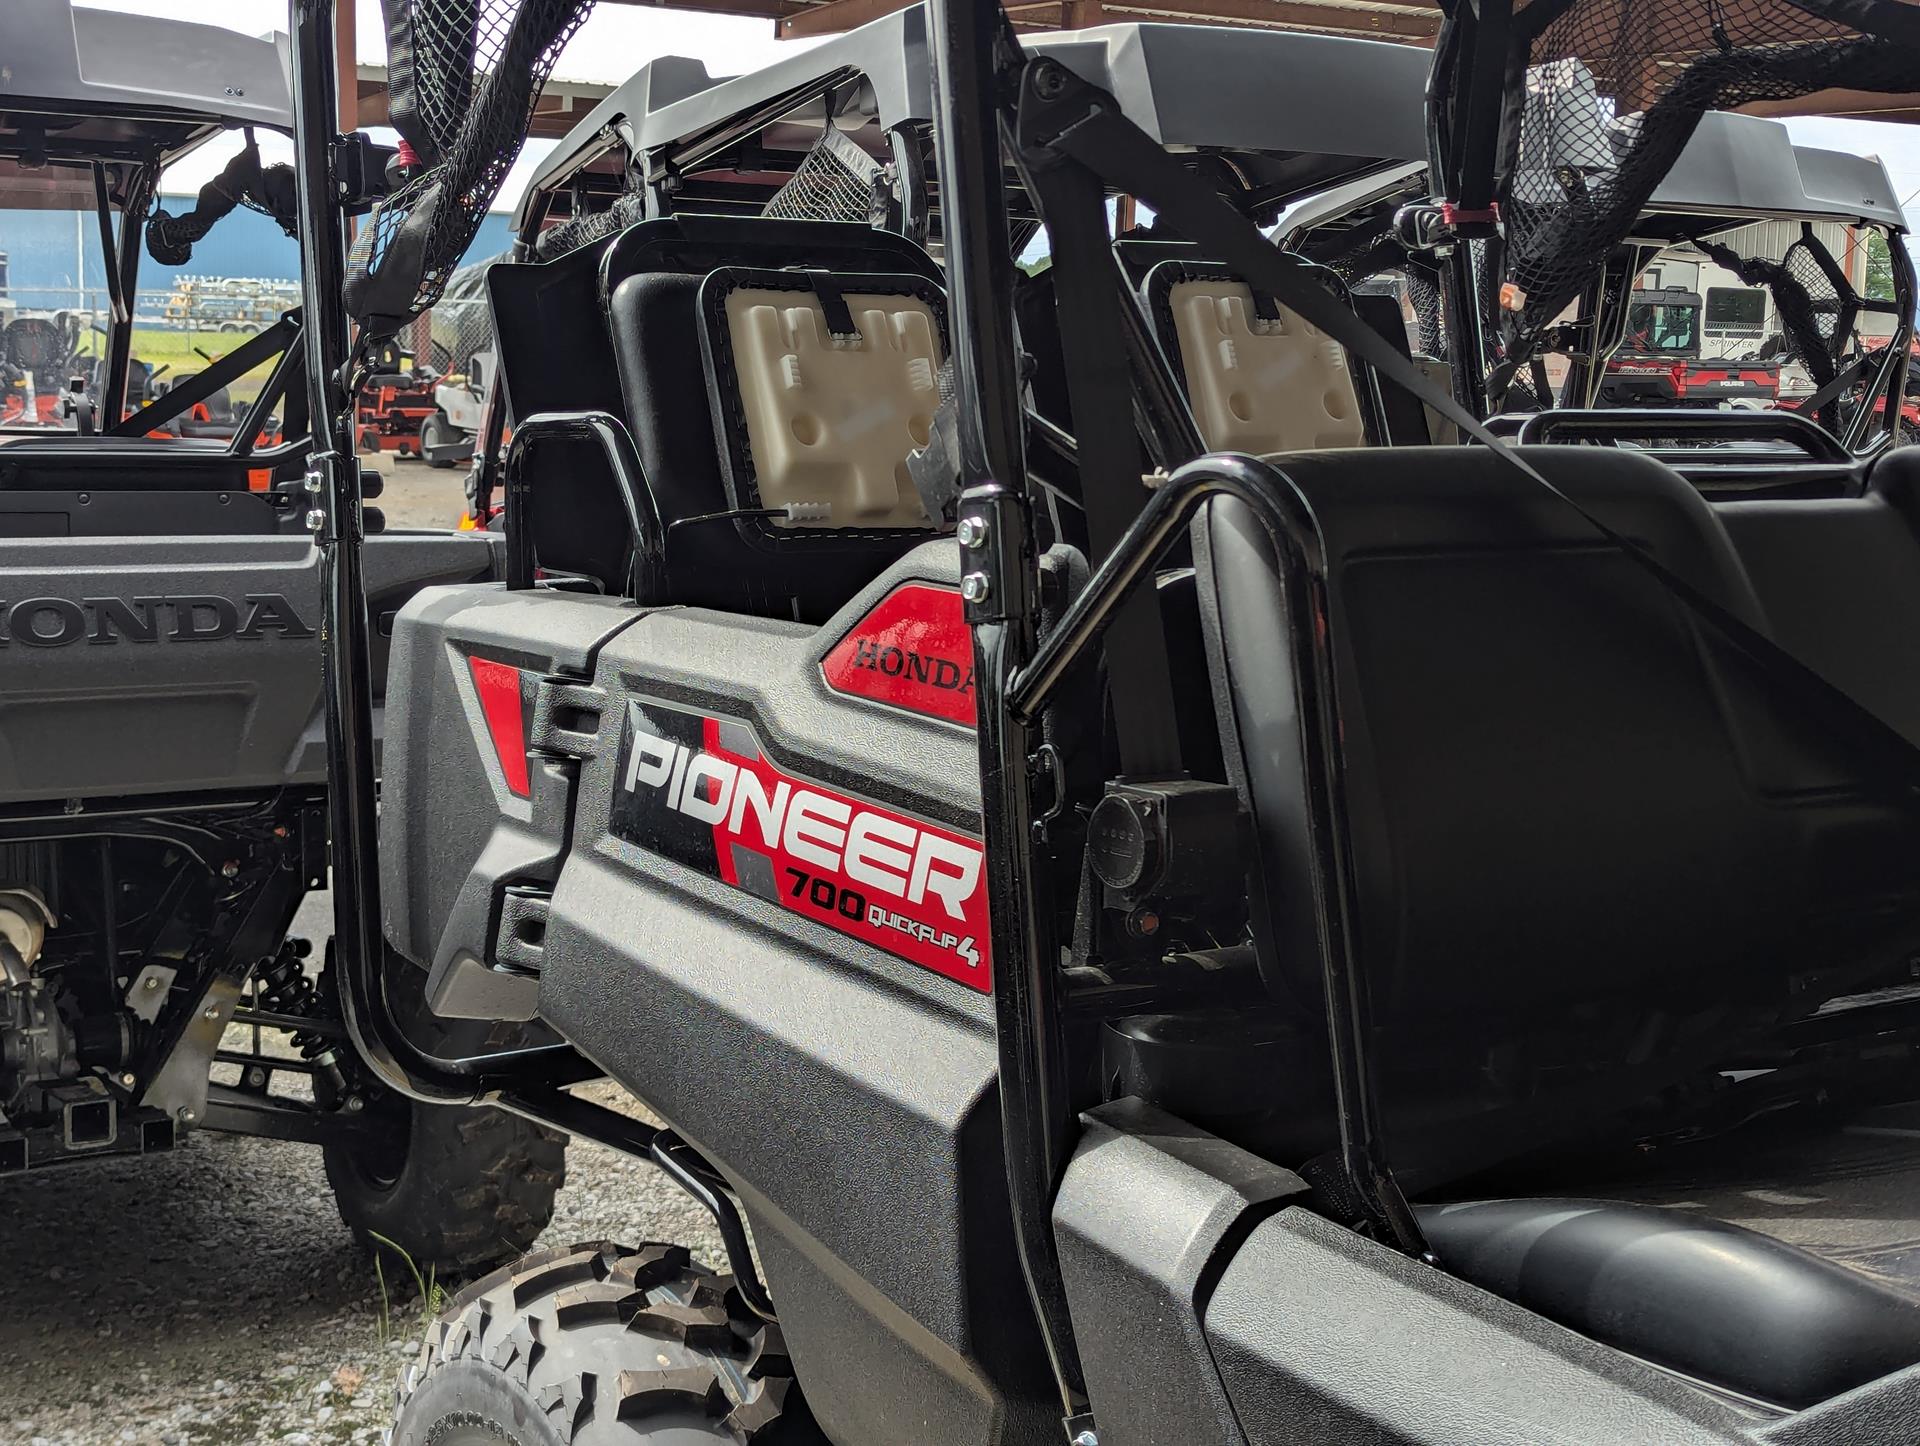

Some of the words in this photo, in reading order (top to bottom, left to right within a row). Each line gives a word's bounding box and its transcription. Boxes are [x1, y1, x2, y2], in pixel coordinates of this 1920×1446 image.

[0, 594, 317, 647] ONDA
[624, 729, 984, 922] PIONEER
[785, 866, 866, 922] 700
